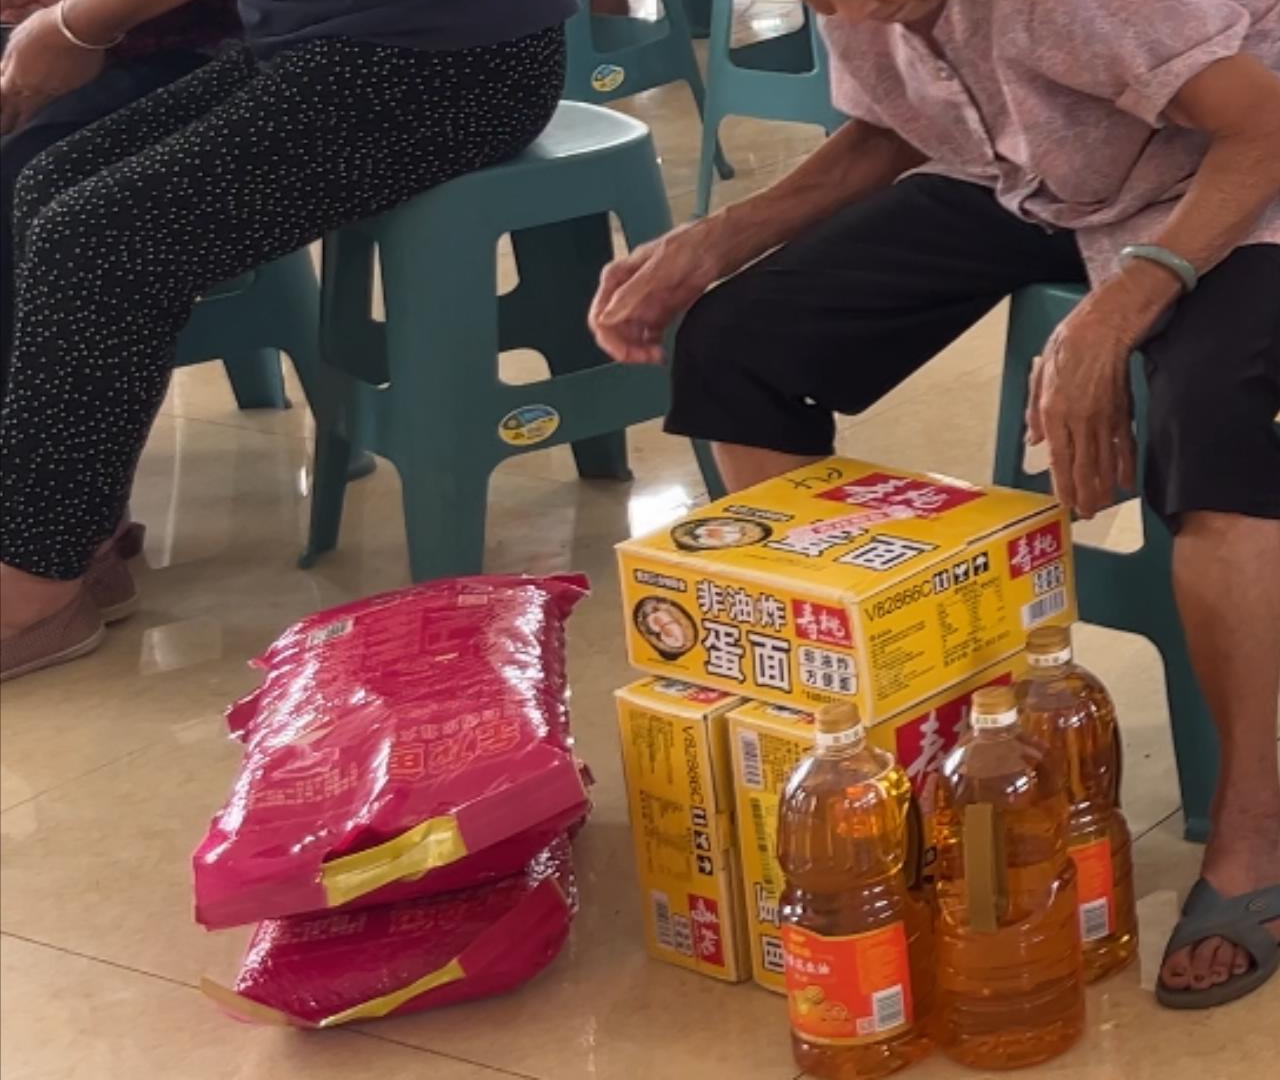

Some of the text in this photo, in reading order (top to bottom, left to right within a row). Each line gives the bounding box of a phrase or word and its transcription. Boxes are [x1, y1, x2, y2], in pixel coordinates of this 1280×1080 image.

[695, 581, 787, 632] 非油炸
[797, 602, 846, 638] 寿桃
[700, 618, 793, 693] 蛋面
